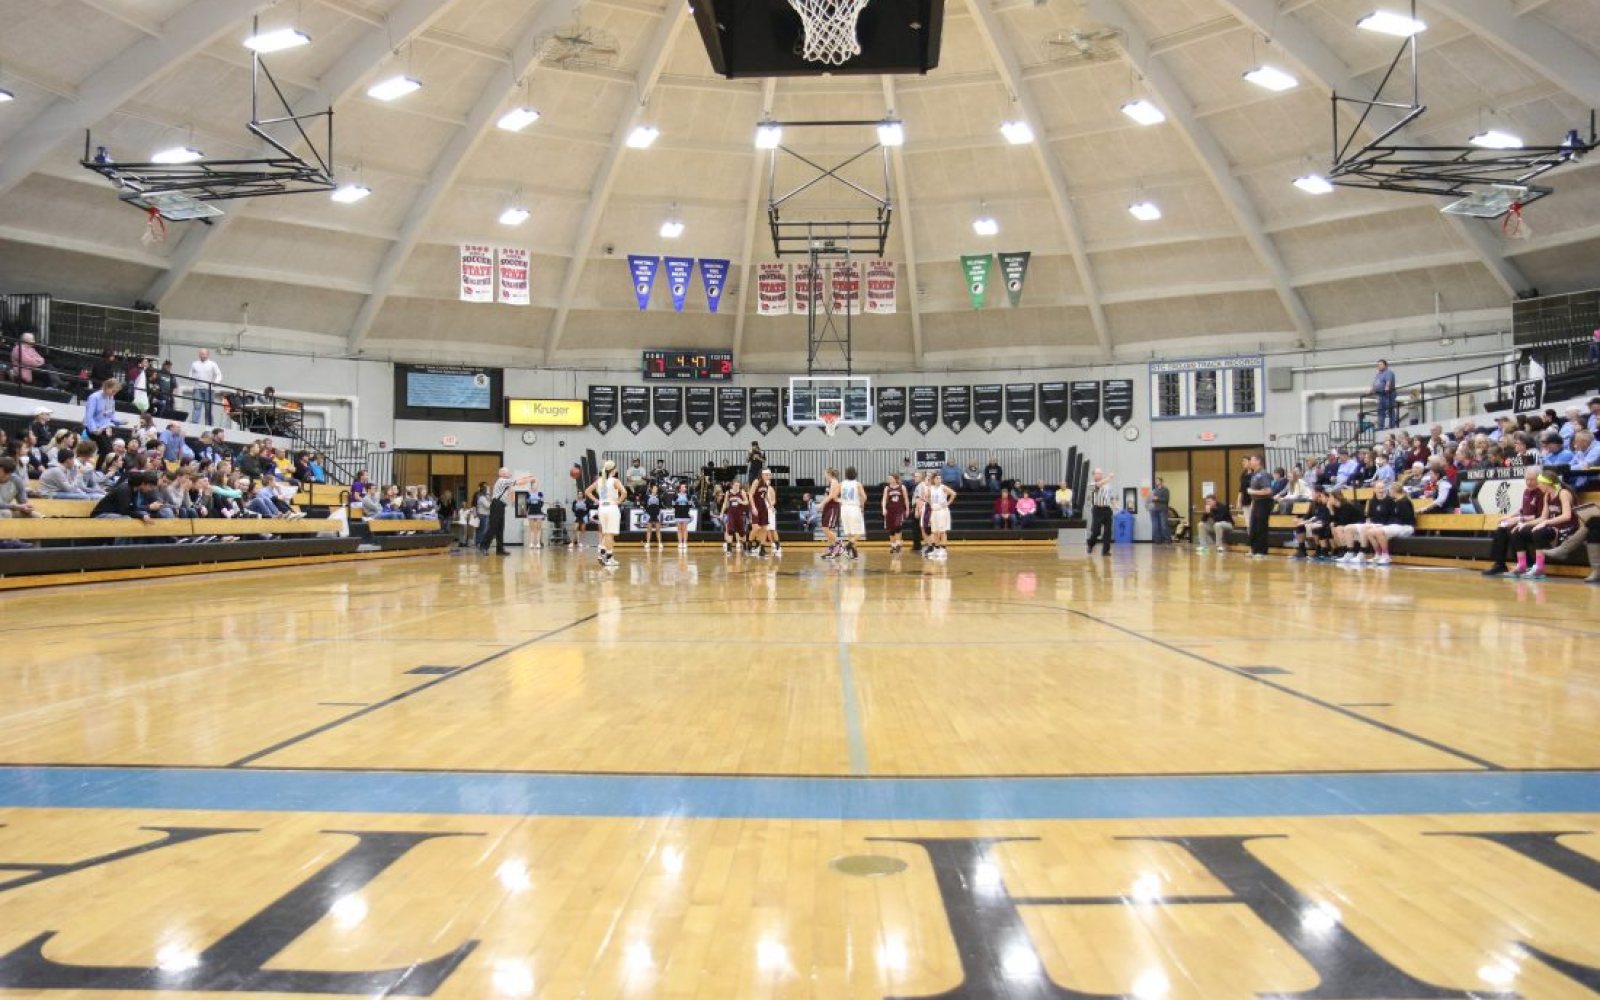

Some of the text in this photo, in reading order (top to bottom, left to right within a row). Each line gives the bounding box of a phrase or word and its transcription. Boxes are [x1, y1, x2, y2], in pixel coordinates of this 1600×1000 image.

[462, 255, 492, 265] SOCCER
[462, 265, 492, 276] STATE
[759, 282, 786, 293] STATE
[867, 280, 894, 290] STATE
[533, 402, 570, 416] Kruger
